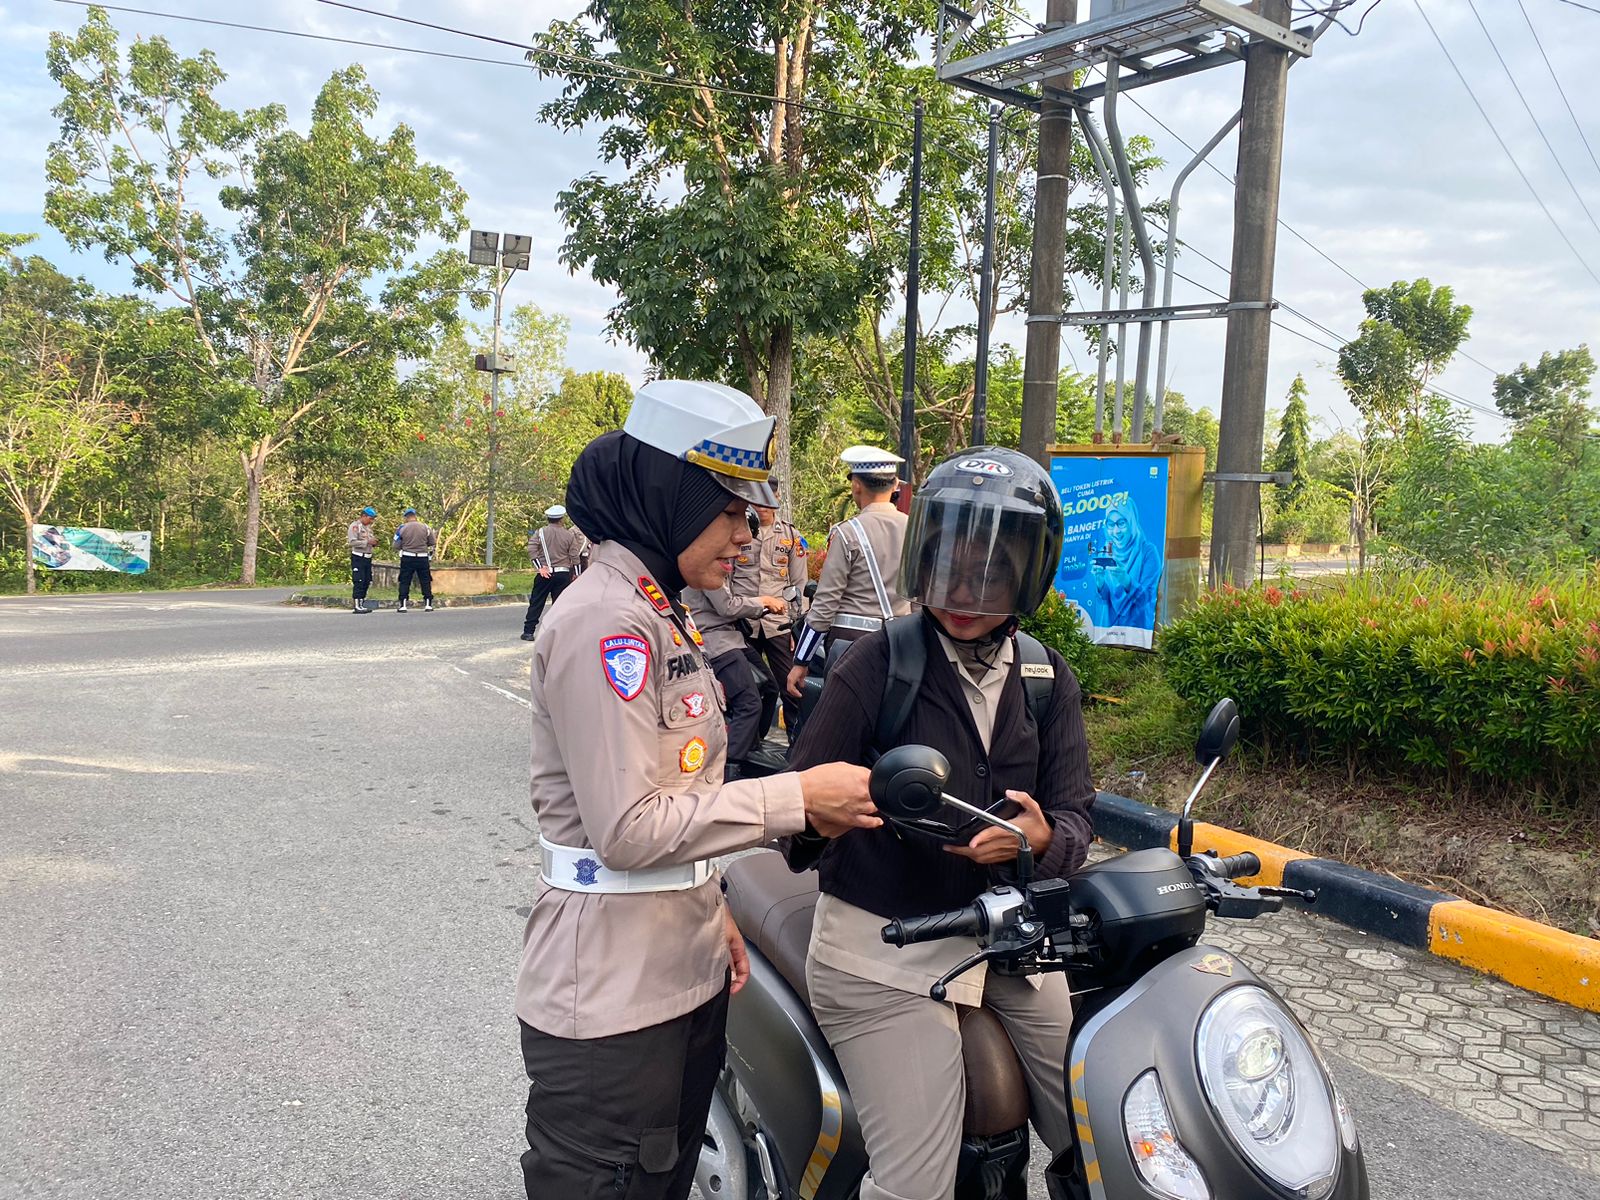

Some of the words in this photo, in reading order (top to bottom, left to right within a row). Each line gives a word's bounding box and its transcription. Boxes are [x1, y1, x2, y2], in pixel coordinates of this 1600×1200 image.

[1061, 486, 1072, 495] BELI
[1073, 481, 1091, 492] TOKEN
[1091, 478, 1114, 488] LISTRIK
[1077, 488, 1095, 498] CUMA
[1064, 534, 1085, 543] HANYA
[1063, 555, 1077, 564] PLN
[604, 638, 623, 648] LALU
[1156, 882, 1195, 896] HONDA
